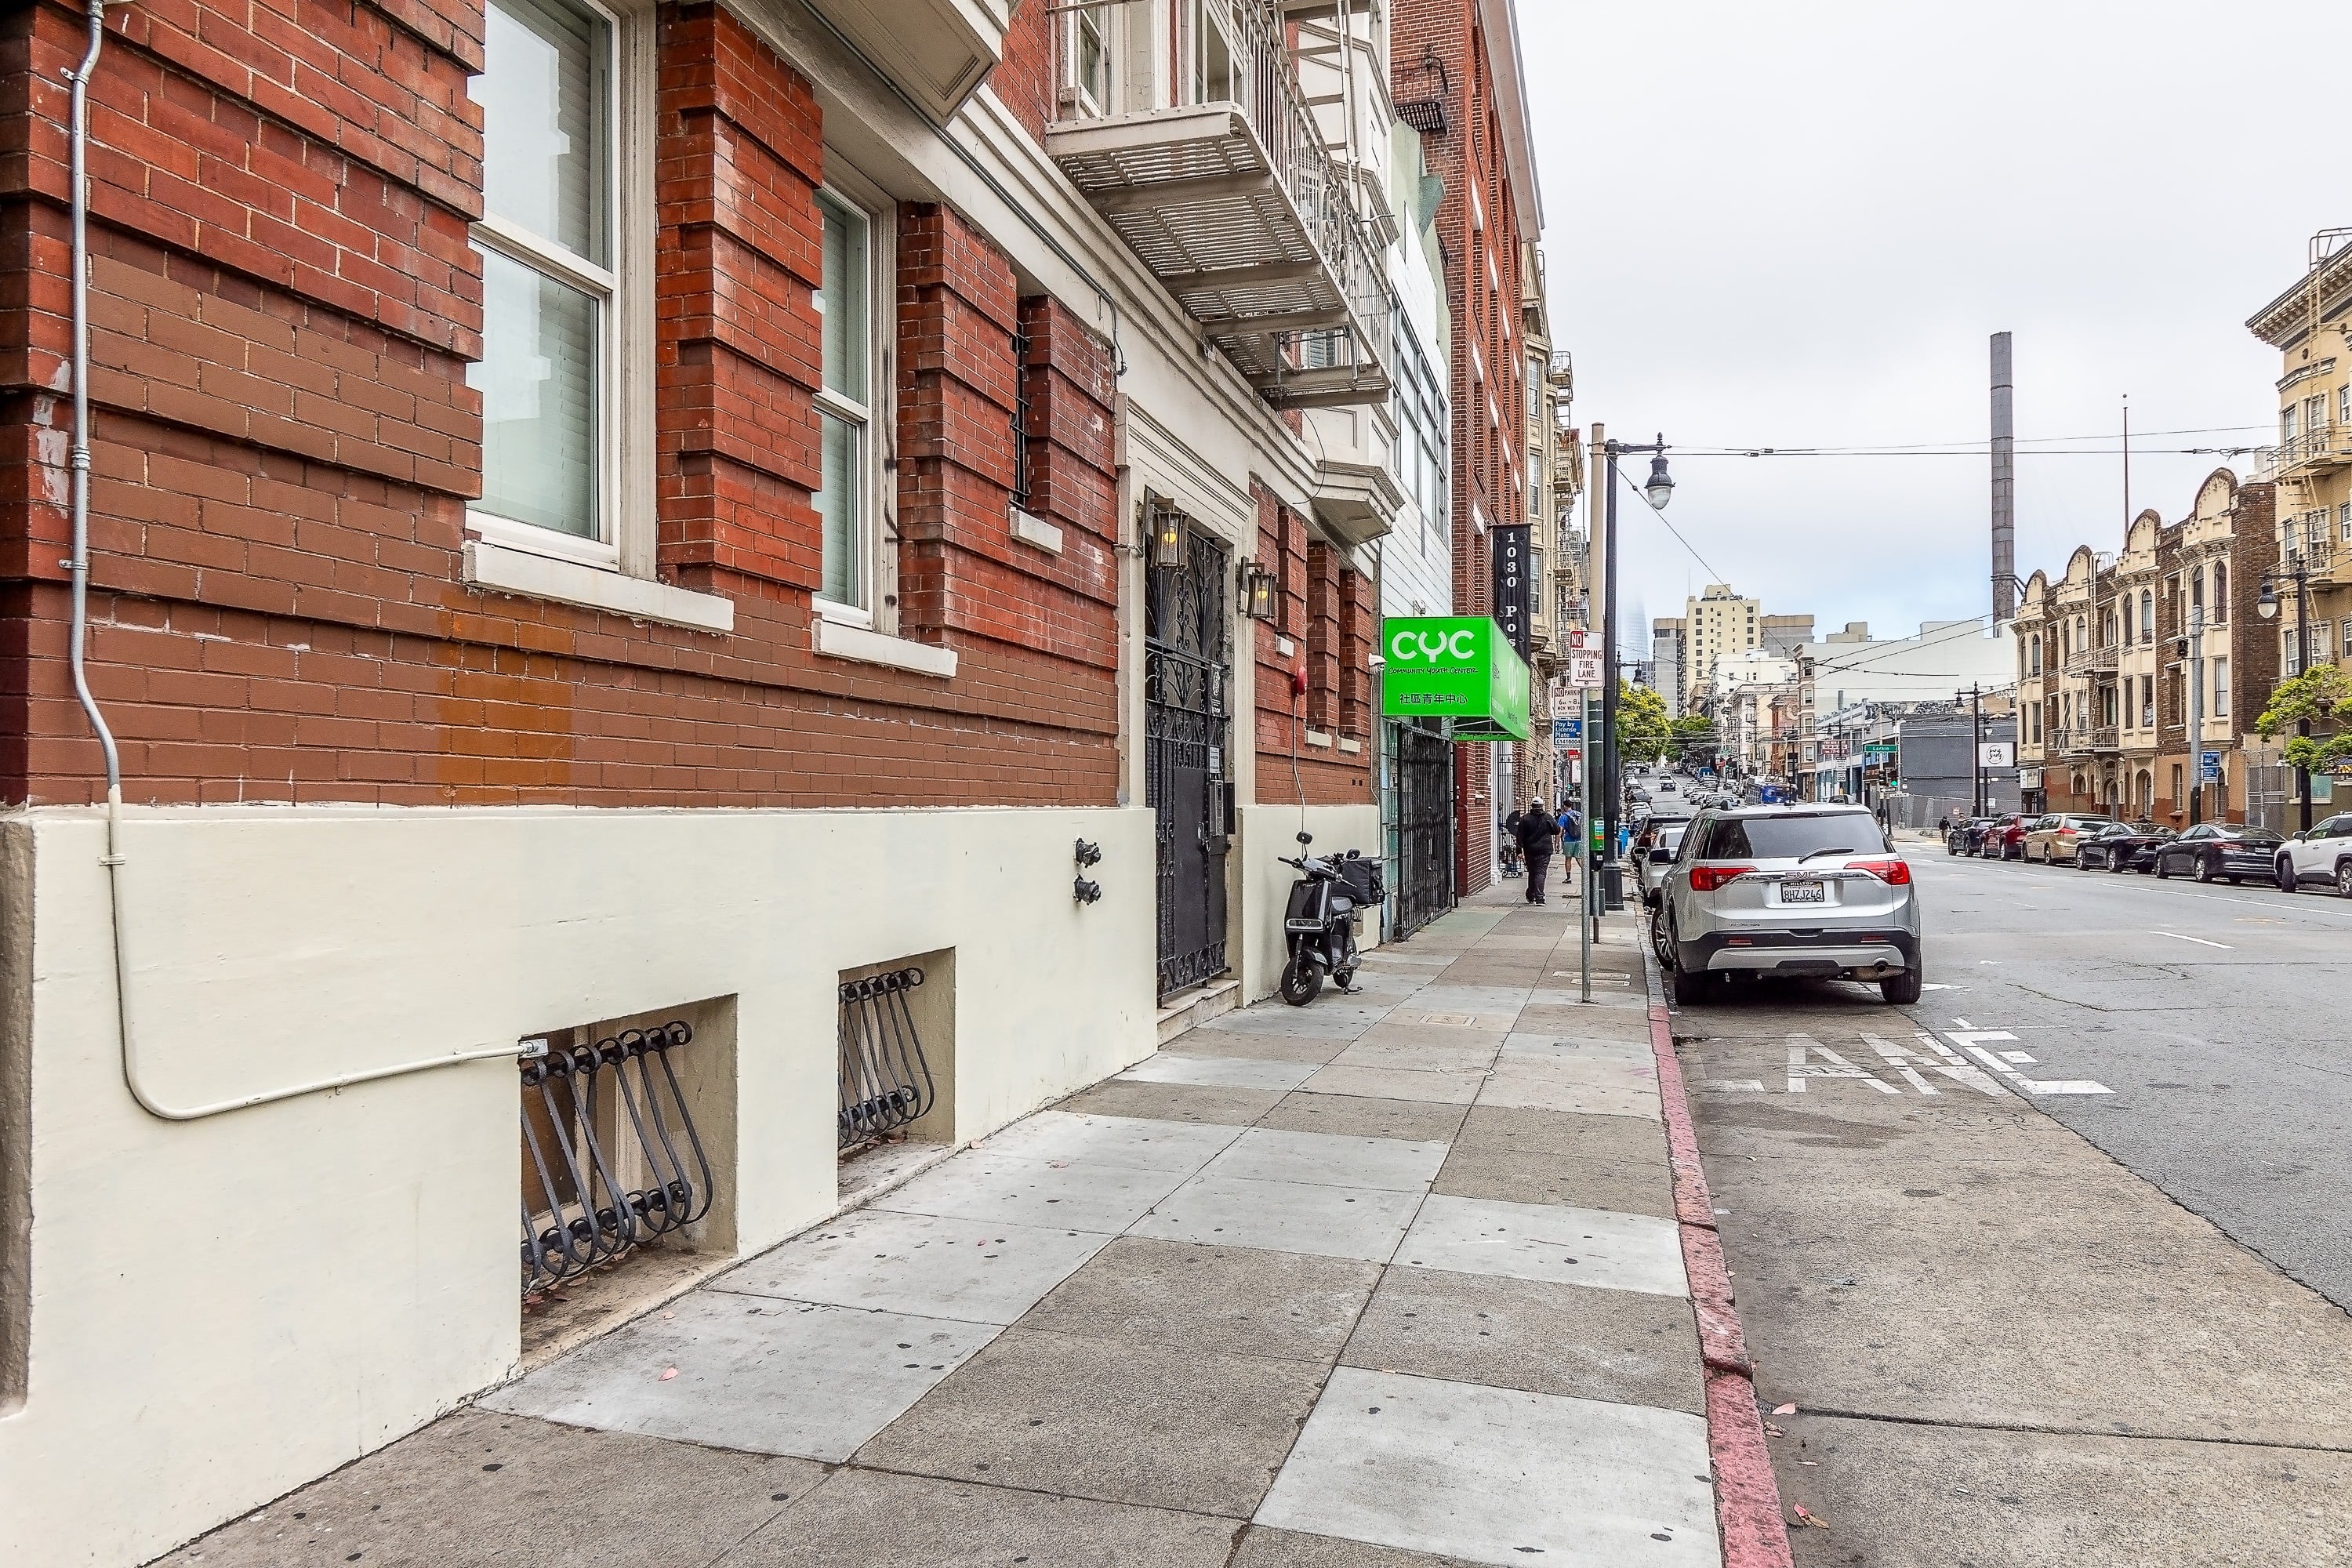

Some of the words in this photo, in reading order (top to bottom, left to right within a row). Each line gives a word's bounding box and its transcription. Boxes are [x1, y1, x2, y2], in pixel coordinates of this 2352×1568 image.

[1507, 532, 1517, 587] 1030
[1571, 633, 1582, 646] NO
[1392, 630, 1475, 663] CYC
[1572, 649, 1602, 659] STOPPING
[1579, 660, 1594, 669] FIRE
[1578, 670, 1596, 678] LANE
[1399, 693, 1468, 704] 社區青年中心
[1784, 889, 1821, 900] 8HZJ246
